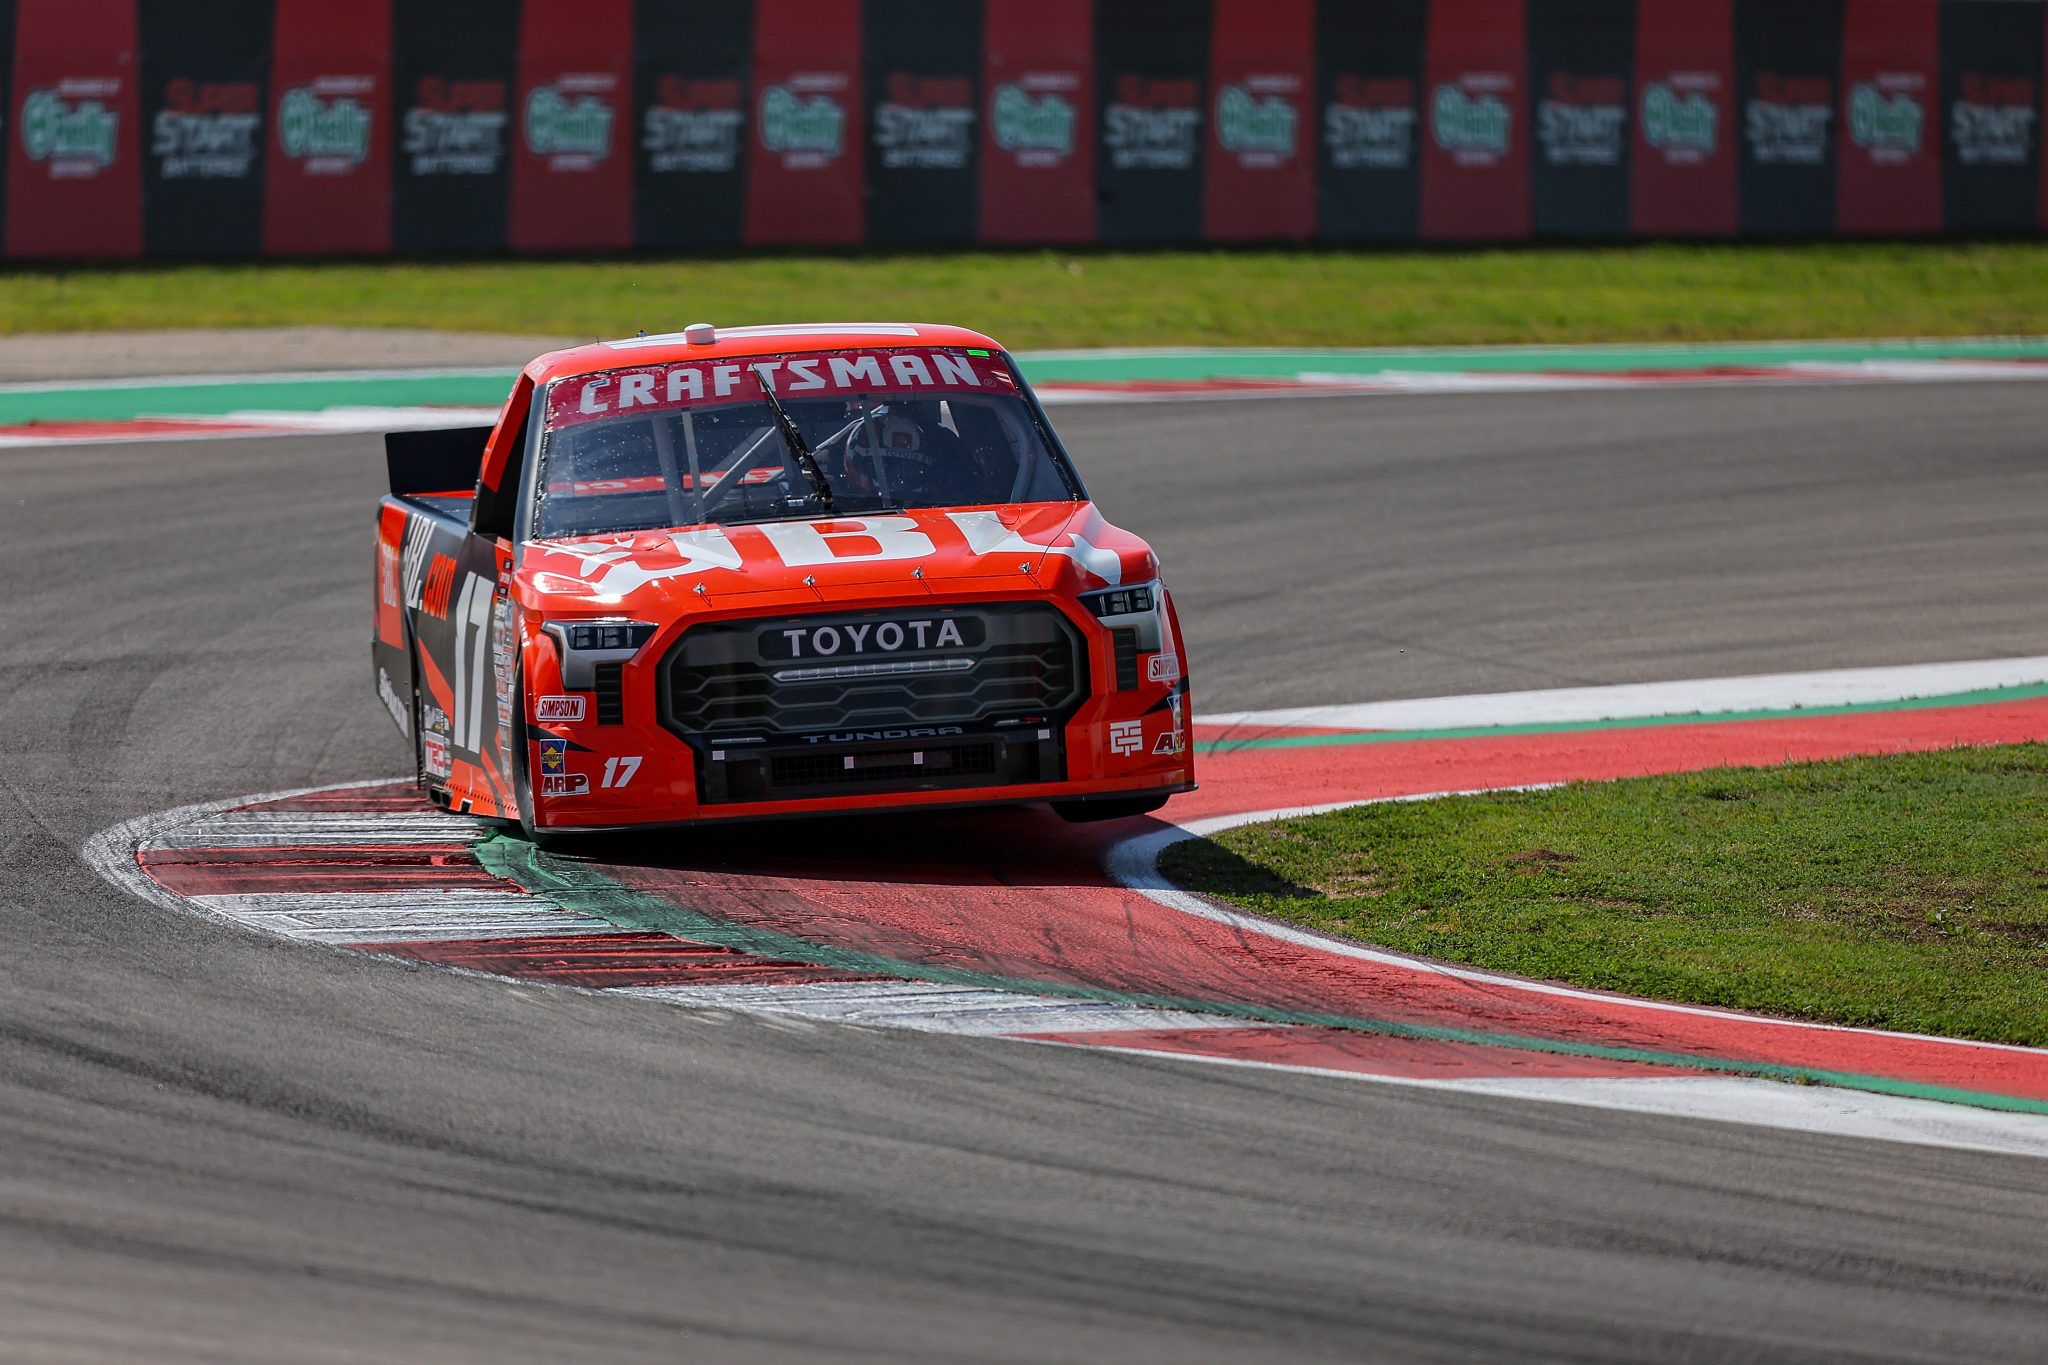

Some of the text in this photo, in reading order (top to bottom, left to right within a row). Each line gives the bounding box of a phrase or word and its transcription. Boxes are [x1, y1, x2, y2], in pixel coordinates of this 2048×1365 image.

[580, 354, 982, 416] CRAFTSMAN
[783, 619, 965, 658] TOYOTA
[454, 570, 495, 755] 17
[540, 700, 580, 717] SIMPSON
[801, 726, 964, 744] TUNDRA
[601, 756, 643, 788] 17
